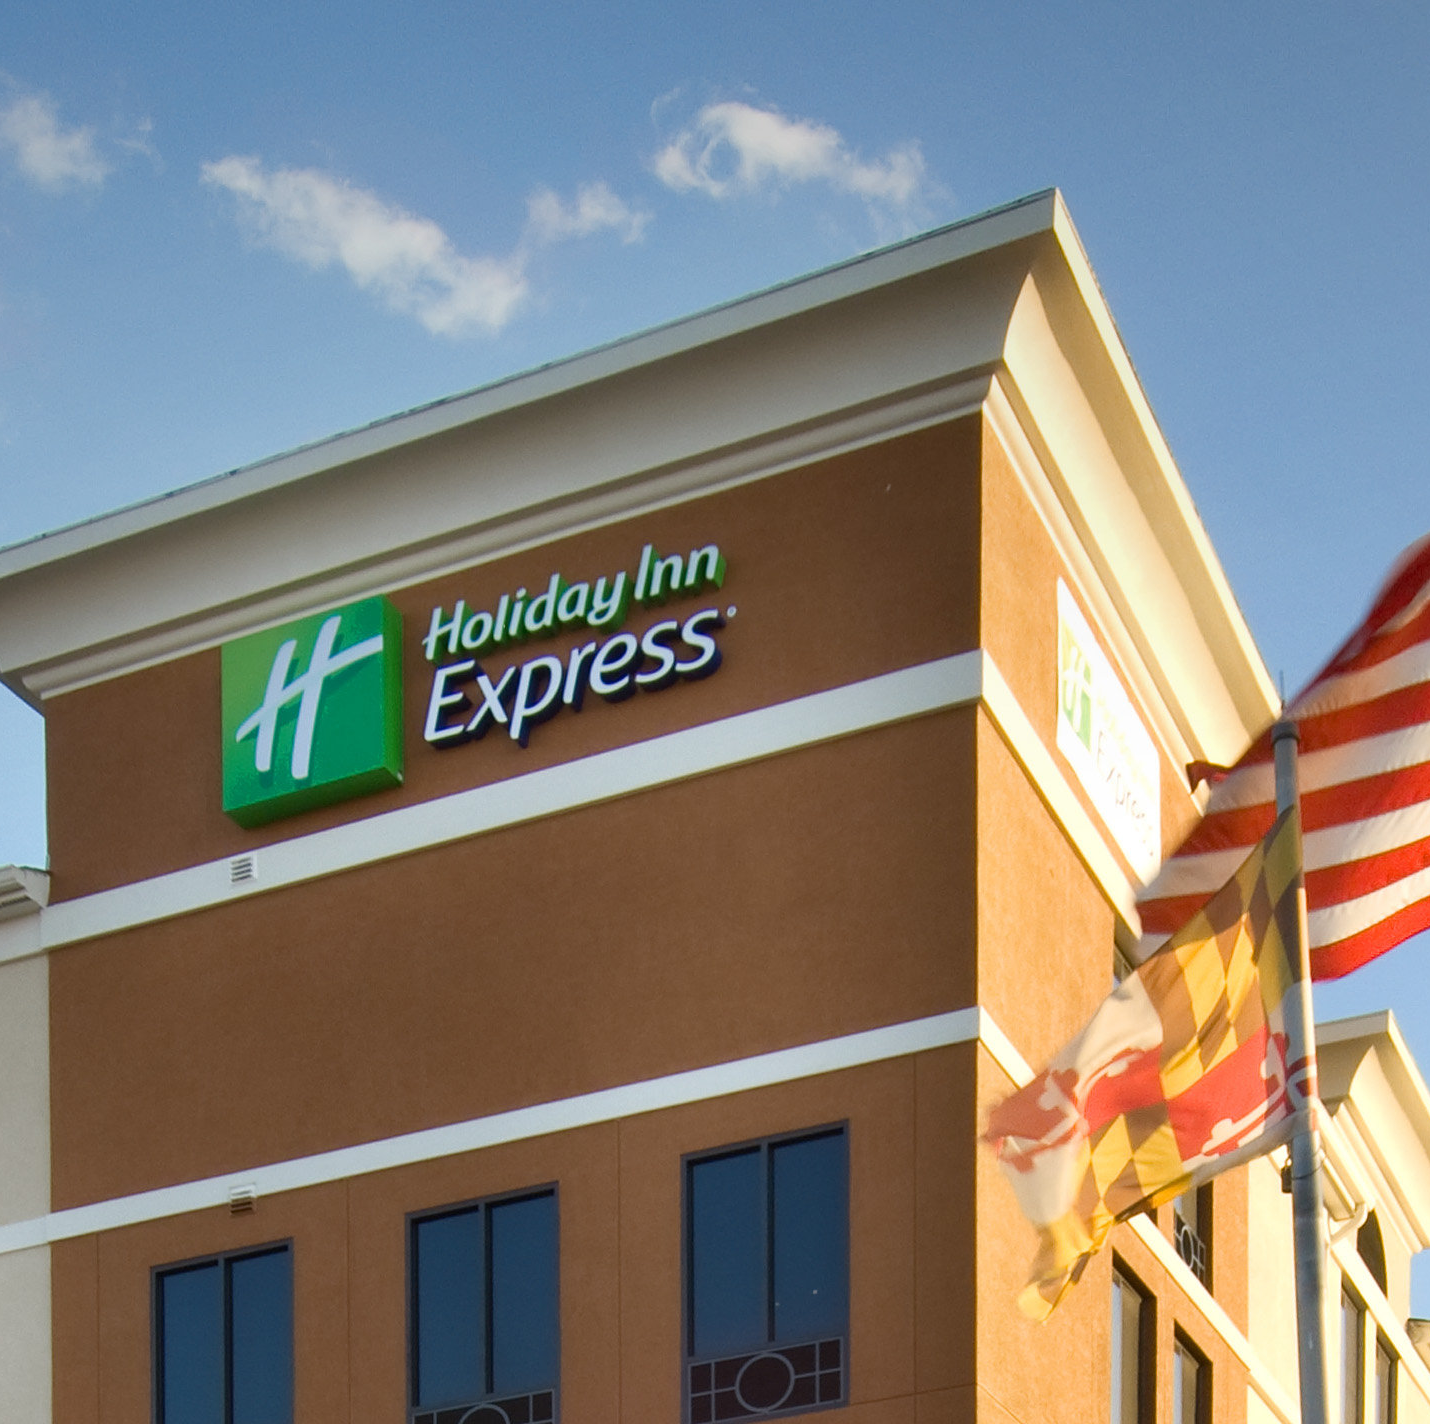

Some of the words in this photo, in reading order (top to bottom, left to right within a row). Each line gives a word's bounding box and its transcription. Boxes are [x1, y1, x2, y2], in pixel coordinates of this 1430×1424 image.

[423, 571, 627, 662] Holiday
[635, 543, 719, 599] Inn
[424, 608, 720, 741] Express
